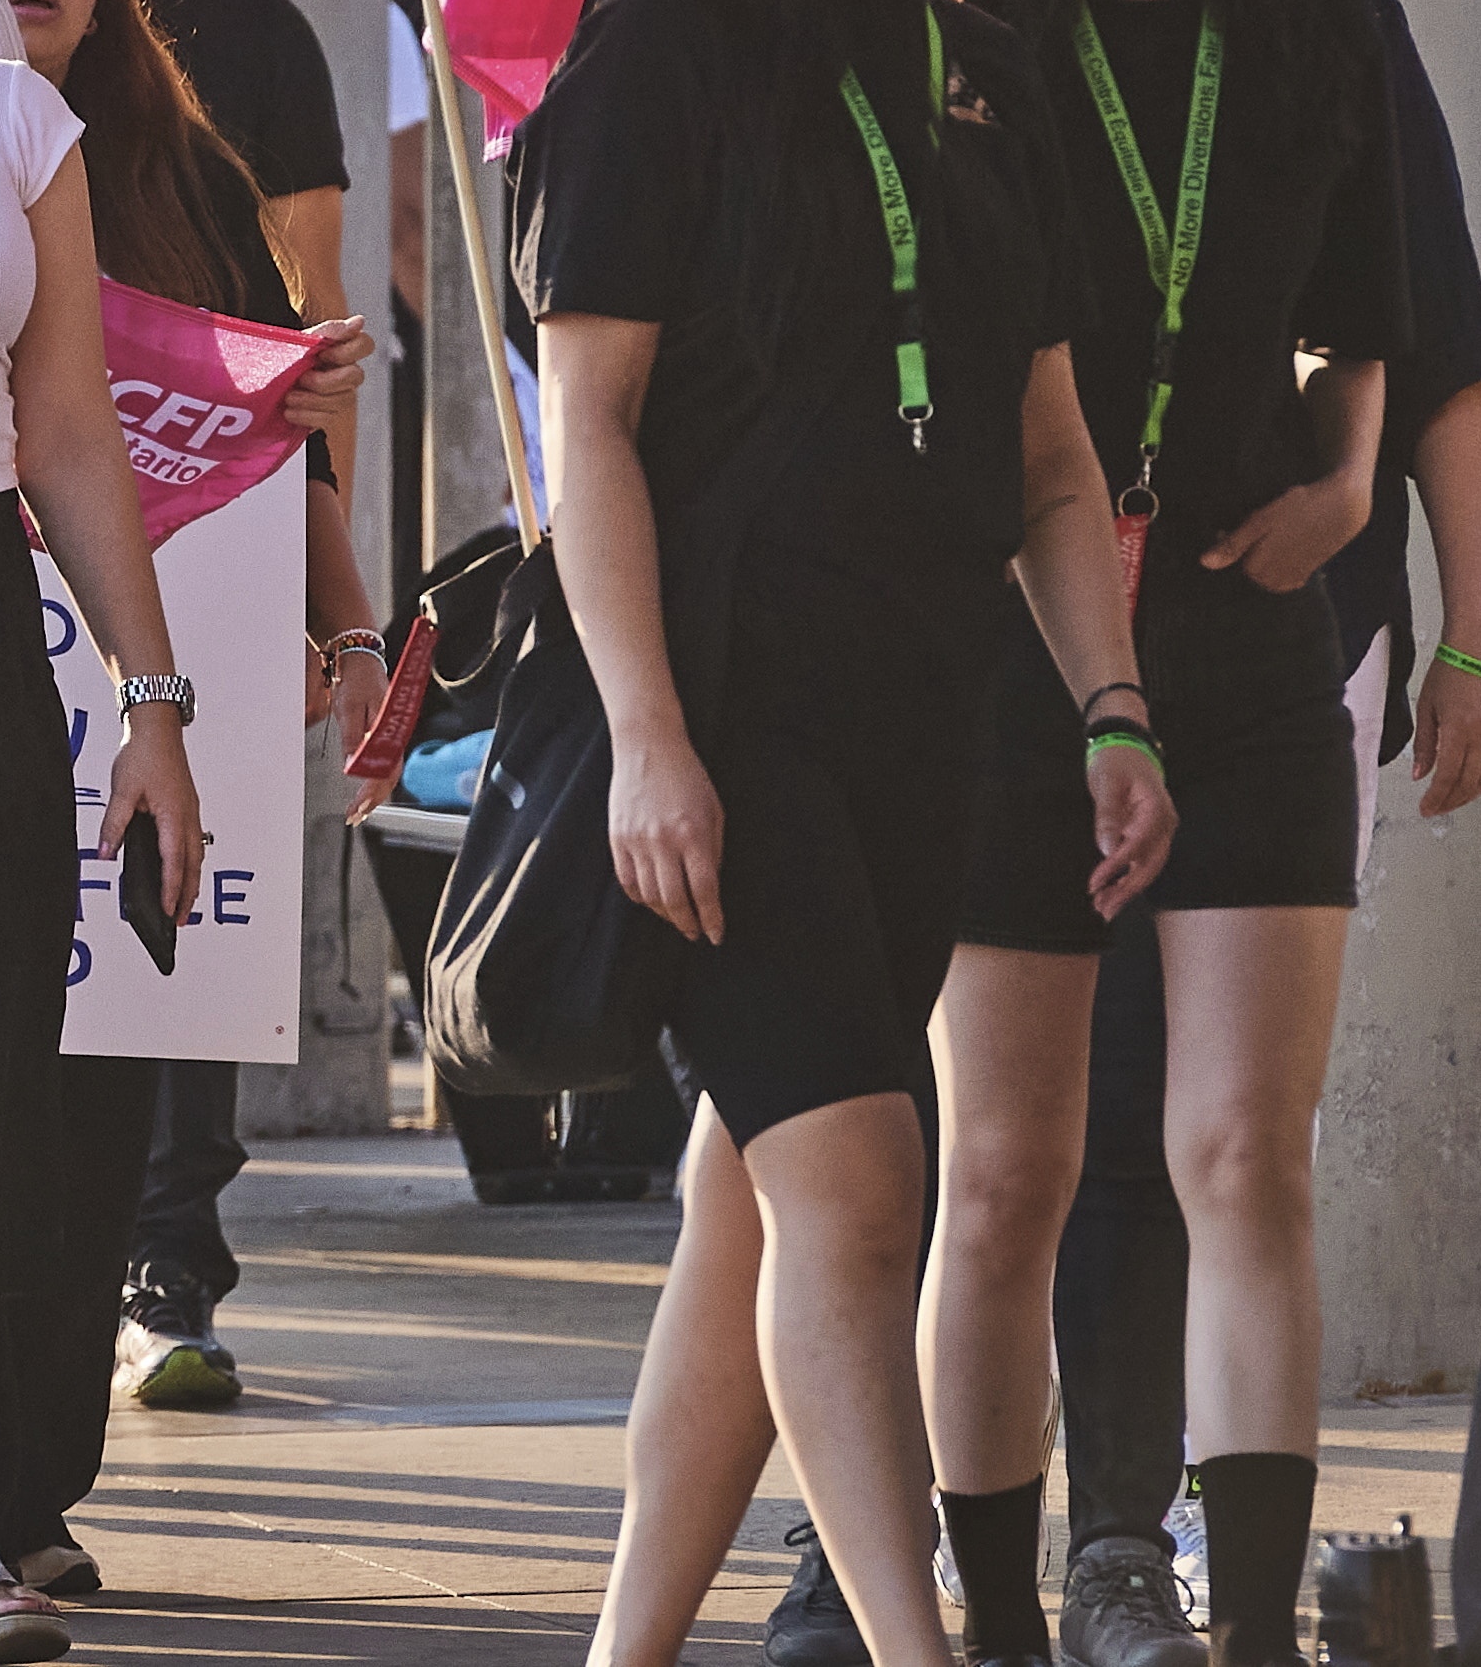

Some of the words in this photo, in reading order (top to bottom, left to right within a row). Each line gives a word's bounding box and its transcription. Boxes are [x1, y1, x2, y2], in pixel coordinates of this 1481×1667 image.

[879, 154, 905, 210] More
[891, 212, 914, 248] No
[1177, 196, 1202, 252] More
[1171, 255, 1194, 288] No
[106, 368, 254, 451] CFP
[126, 437, 204, 483] tario
